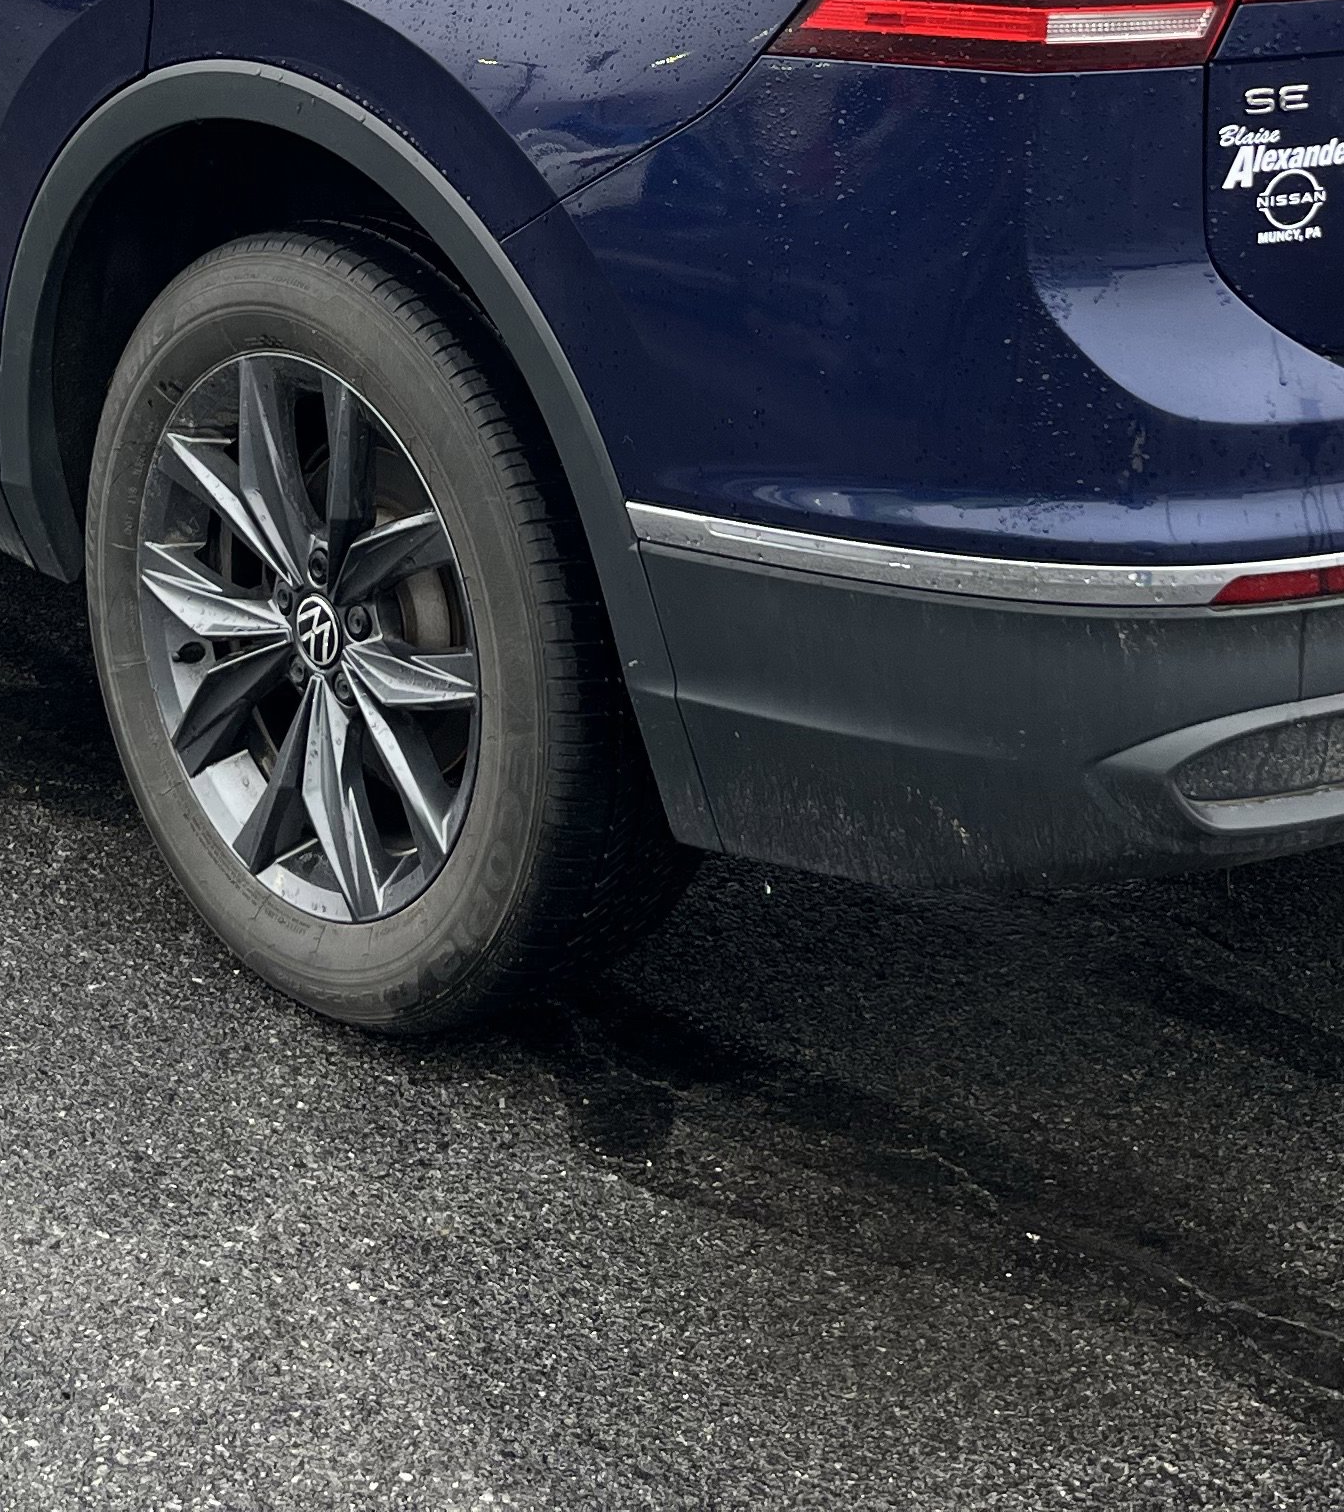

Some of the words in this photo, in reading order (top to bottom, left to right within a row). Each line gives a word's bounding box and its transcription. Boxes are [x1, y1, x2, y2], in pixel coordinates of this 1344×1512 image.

[1244, 84, 1310, 115] SE
[1218, 124, 1281, 147] Blaise
[1256, 191, 1326, 208] NISSAN
[1257, 228, 1304, 244] MUNCY,
[1305, 225, 1323, 239] PA
